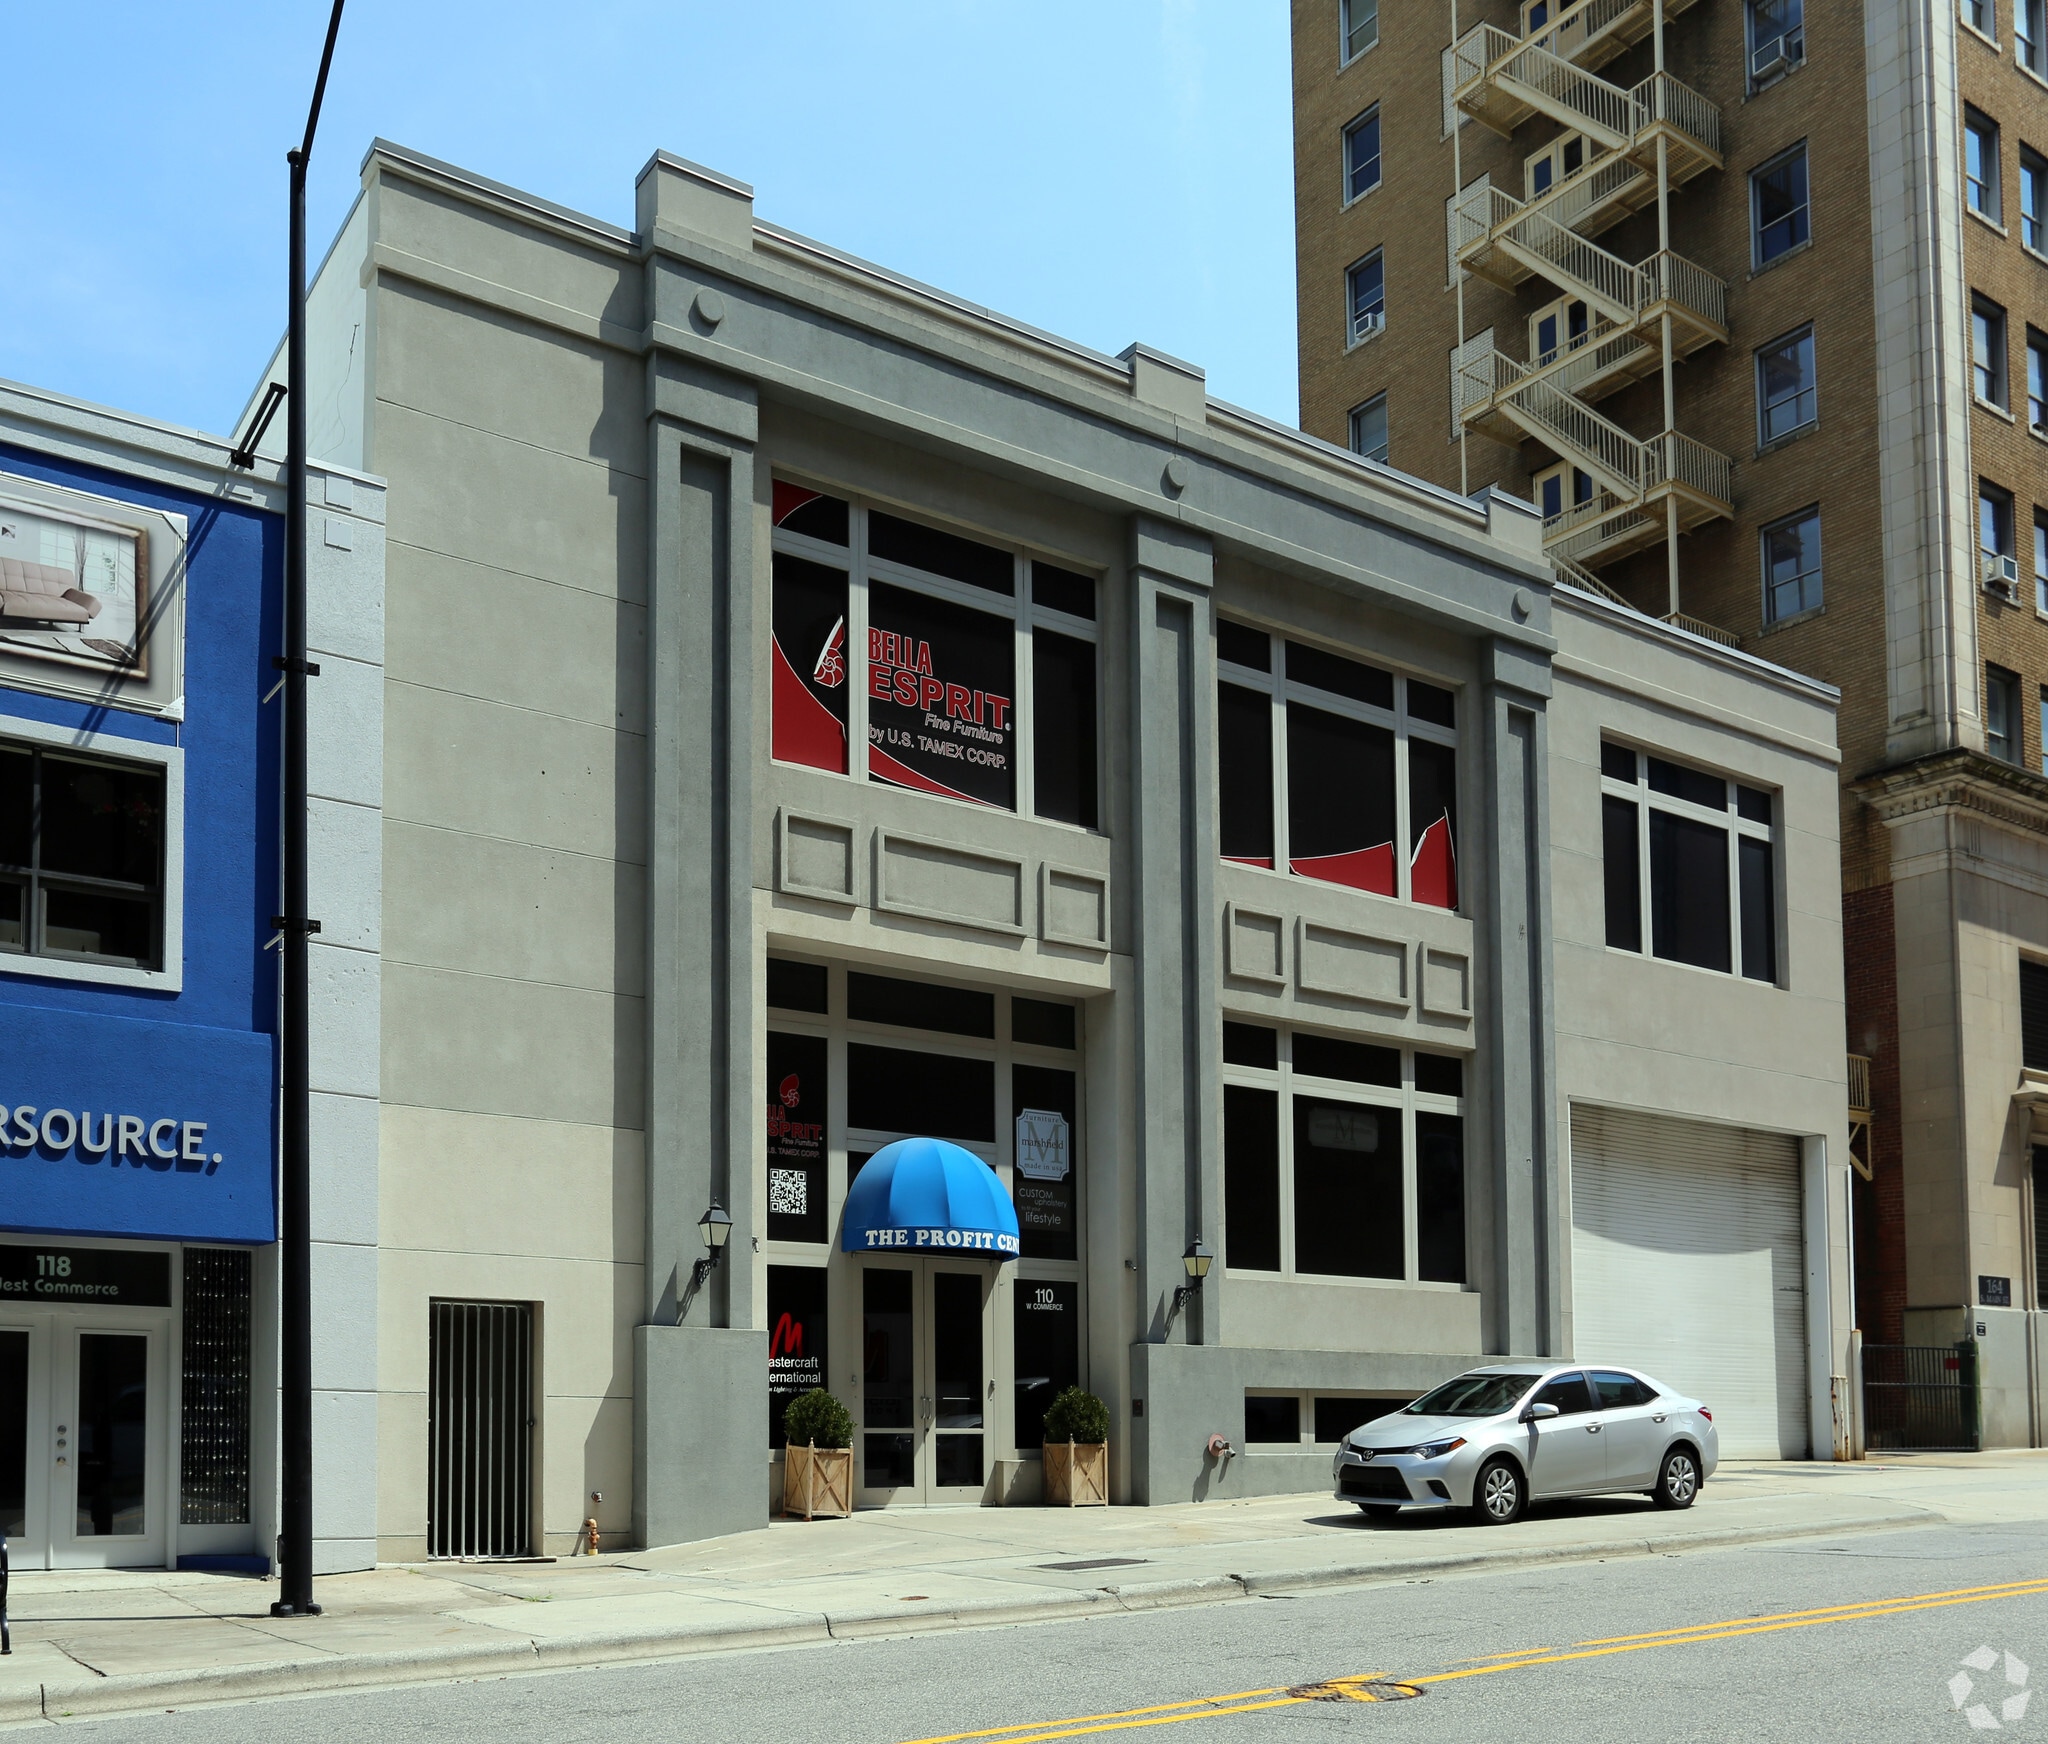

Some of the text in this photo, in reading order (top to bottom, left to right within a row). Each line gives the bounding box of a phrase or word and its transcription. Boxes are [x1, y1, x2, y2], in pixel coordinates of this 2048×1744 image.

[868, 626, 933, 676] BELLA
[868, 662, 1011, 730] ESPRIT
[925, 713, 1004, 745] Fine Furniture
[868, 724, 1007, 769] by U.S. TAMEX CORP.
[1025, 1114, 1060, 1124] furniture
[1021, 1137, 1064, 1150] marshfield
[1024, 1162, 1041, 1171] made
[1018, 1187, 1053, 1200] CUSTOM
[1034, 1199, 1067, 1209] upholstery
[1025, 1211, 1062, 1227] lifestyle
[865, 1229, 909, 1247] THE
[915, 1229, 994, 1249] PROFIT
[36, 1255, 72, 1276] 118
[34, 1279, 119, 1296] Commerce
[1986, 1279, 2003, 1294] 164
[1035, 1288, 1054, 1304] 110
[1986, 1295, 2002, 1304] MAIN
[1026, 1302, 1063, 1311] W COMMERCE
